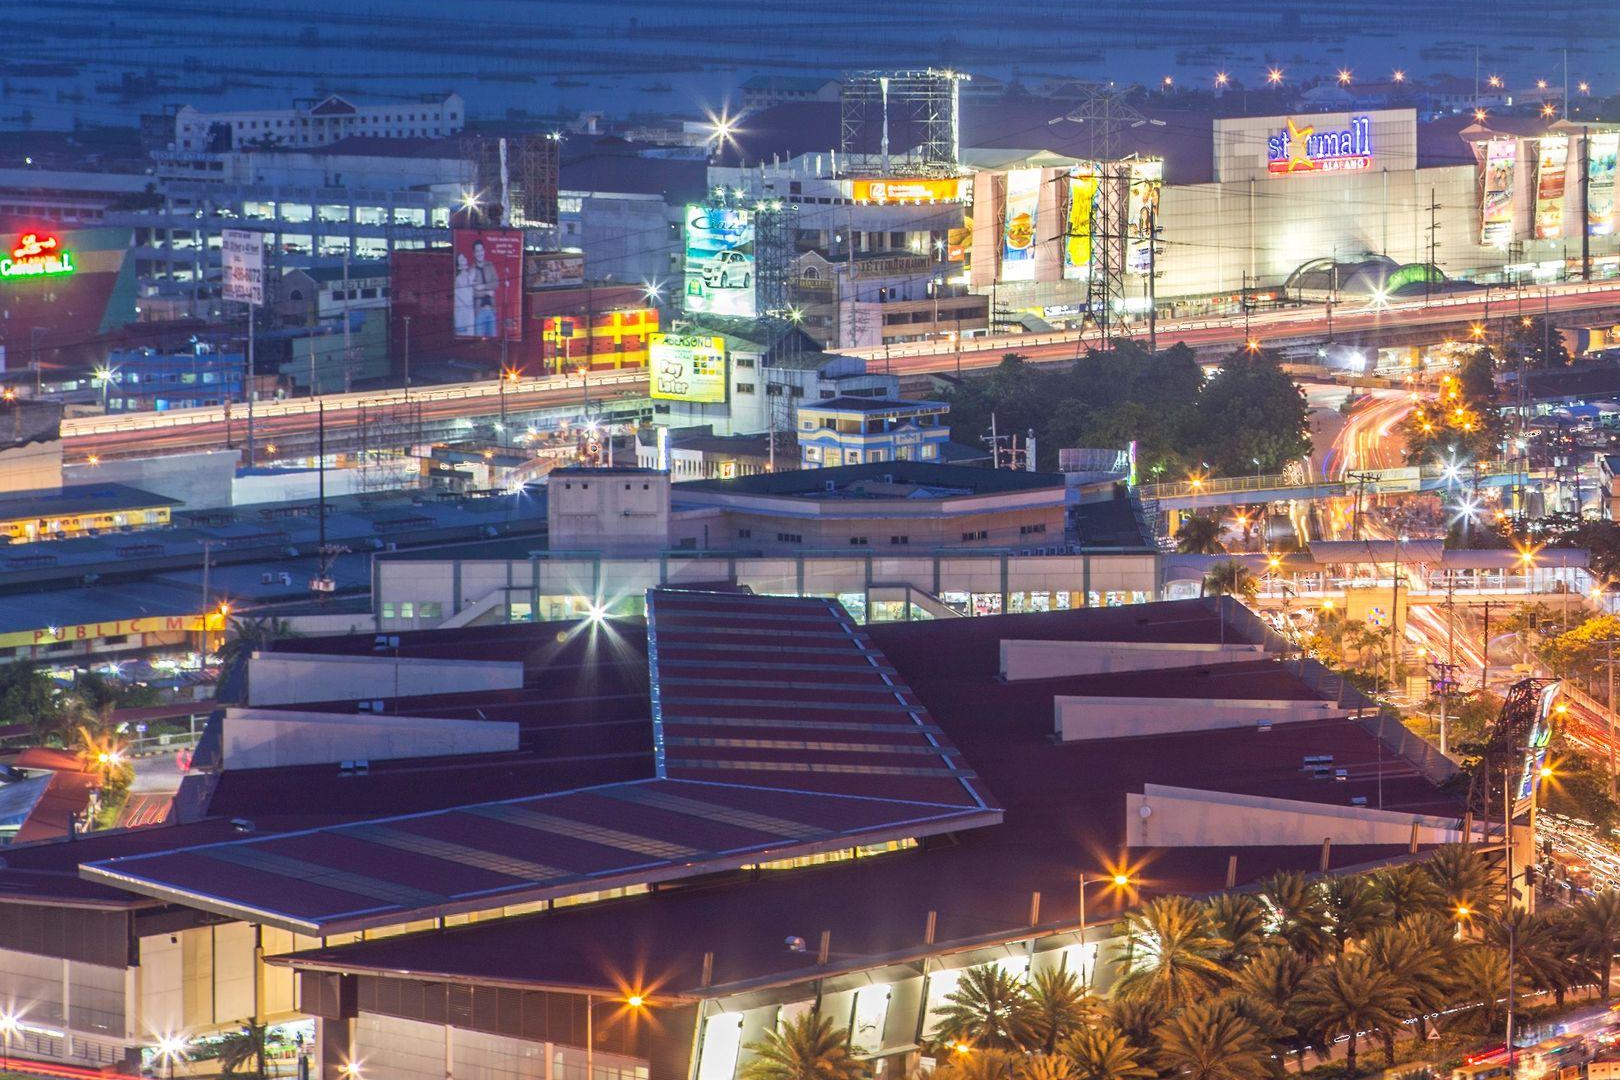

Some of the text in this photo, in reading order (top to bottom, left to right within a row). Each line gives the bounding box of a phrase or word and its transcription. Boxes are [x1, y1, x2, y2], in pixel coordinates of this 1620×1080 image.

[1267, 117, 1371, 160] strmall
[658, 377, 689, 395] Later
[34, 619, 141, 643] PUBLIC
